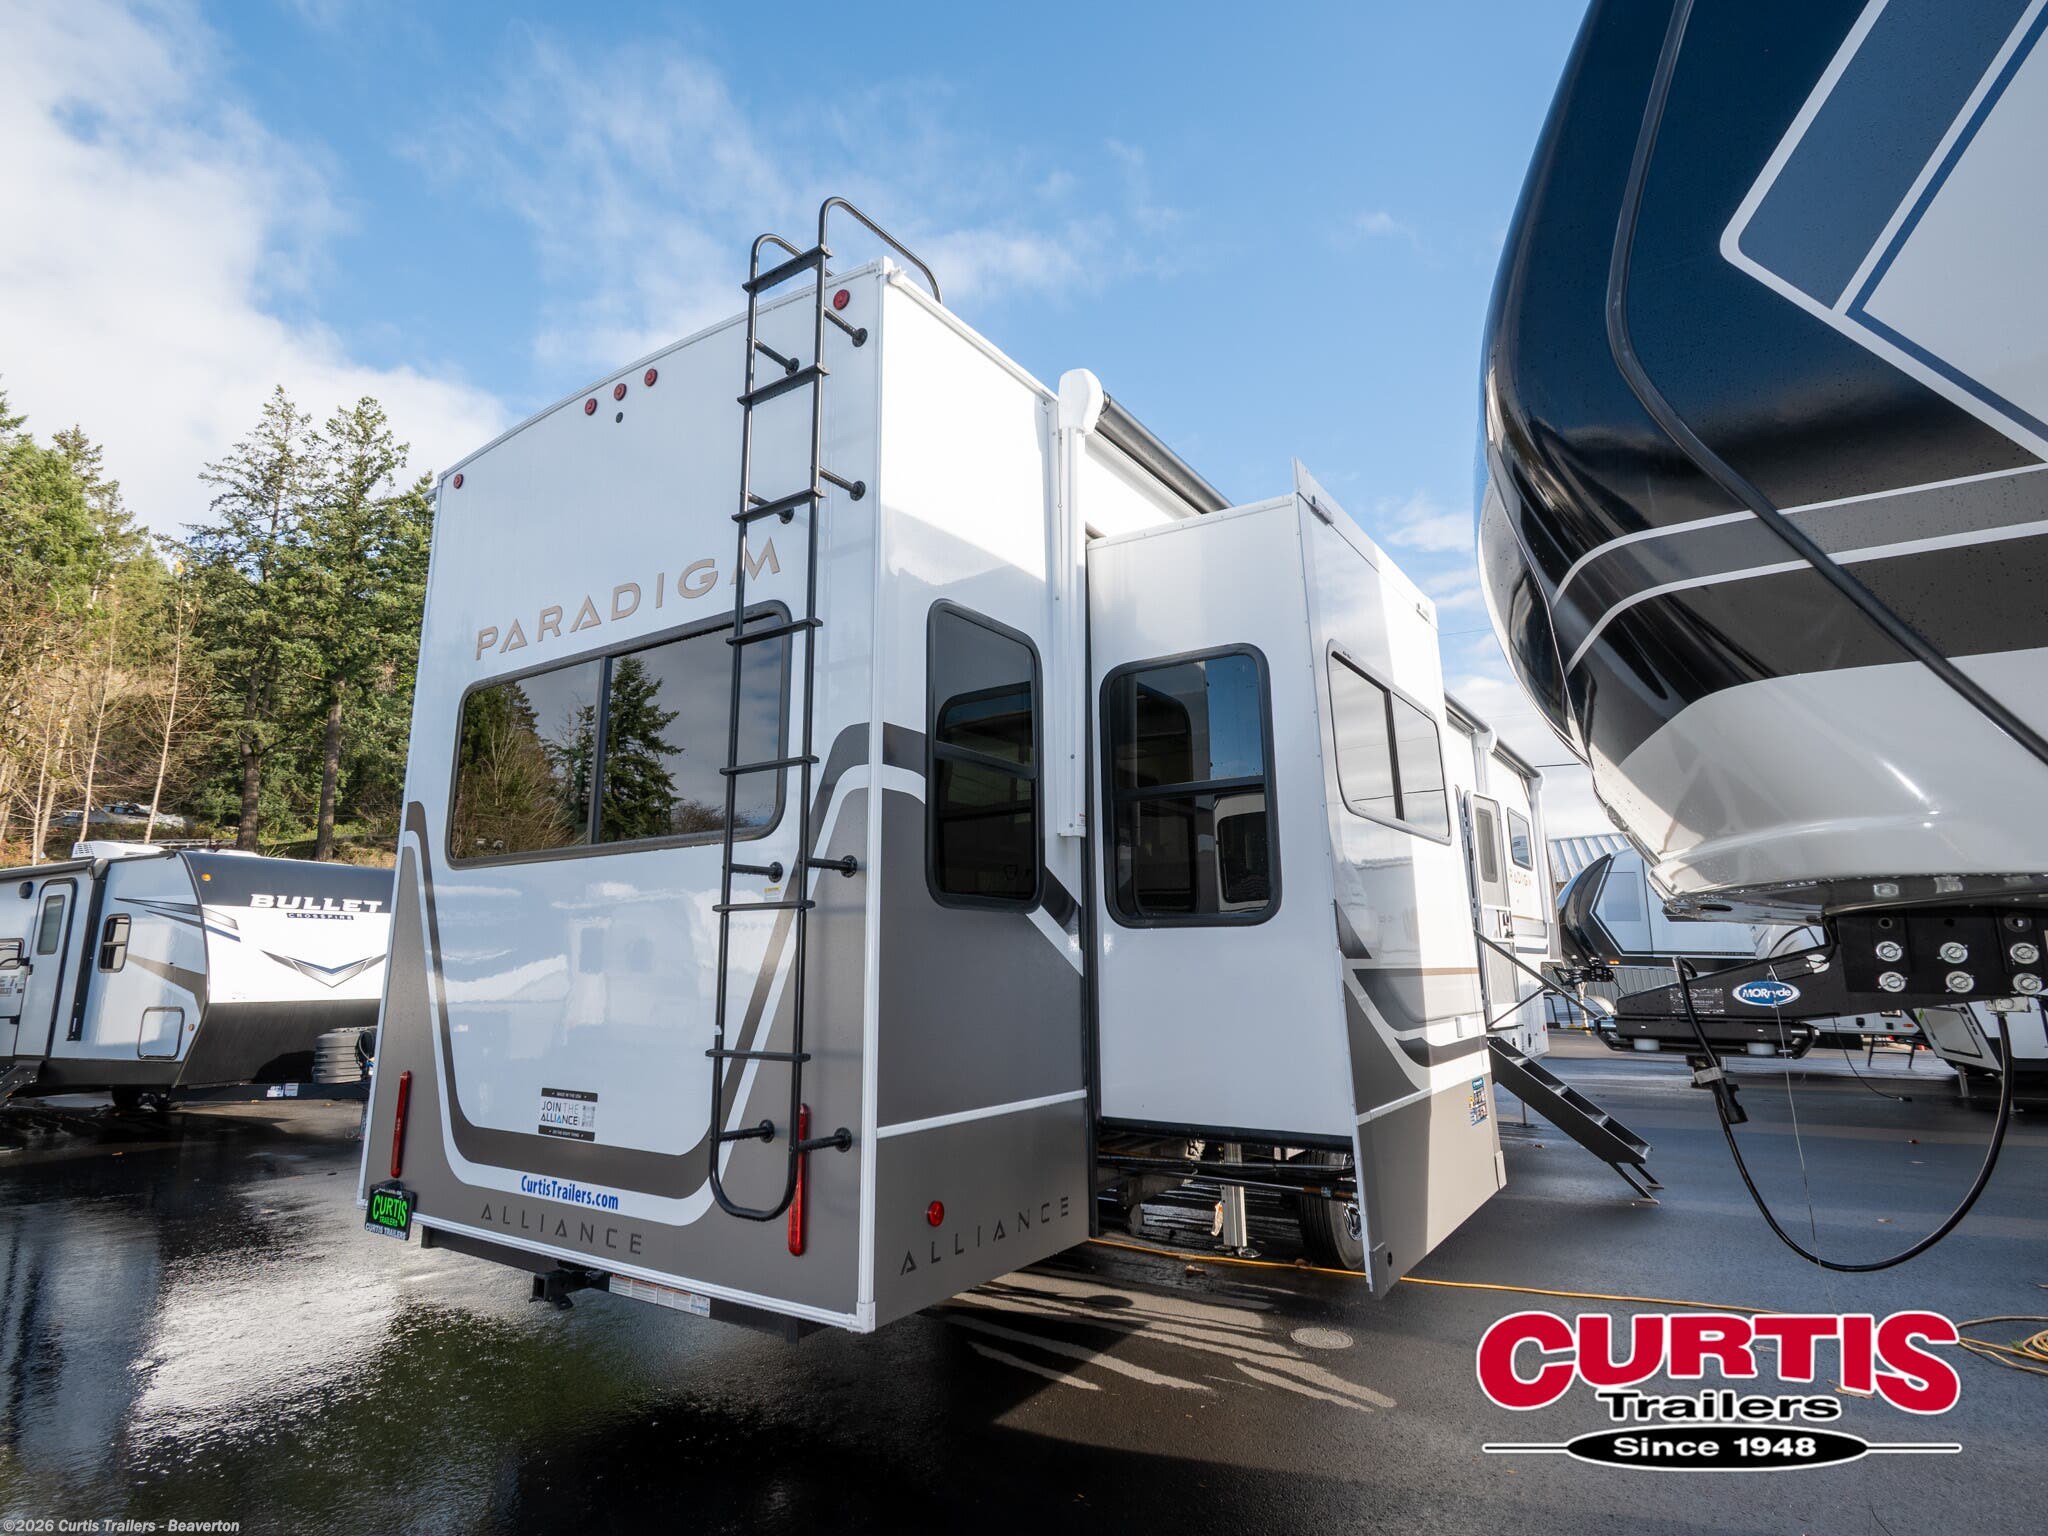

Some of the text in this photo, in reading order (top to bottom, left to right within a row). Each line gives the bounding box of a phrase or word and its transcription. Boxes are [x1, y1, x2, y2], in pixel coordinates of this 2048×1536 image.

[475, 537, 780, 660] PARADIGM
[250, 893, 382, 912] BULLET
[287, 913, 353, 921] CROSSFIRE
[541, 1113, 578, 1126] ALLIANCE
[542, 1100, 561, 1112] JOIN
[521, 1175, 619, 1210] CurtisTrailers.com
[373, 1194, 408, 1227] CURTIS
[480, 1203, 642, 1255] ALLIANCE
[901, 1196, 1069, 1276] ALLIANCE
